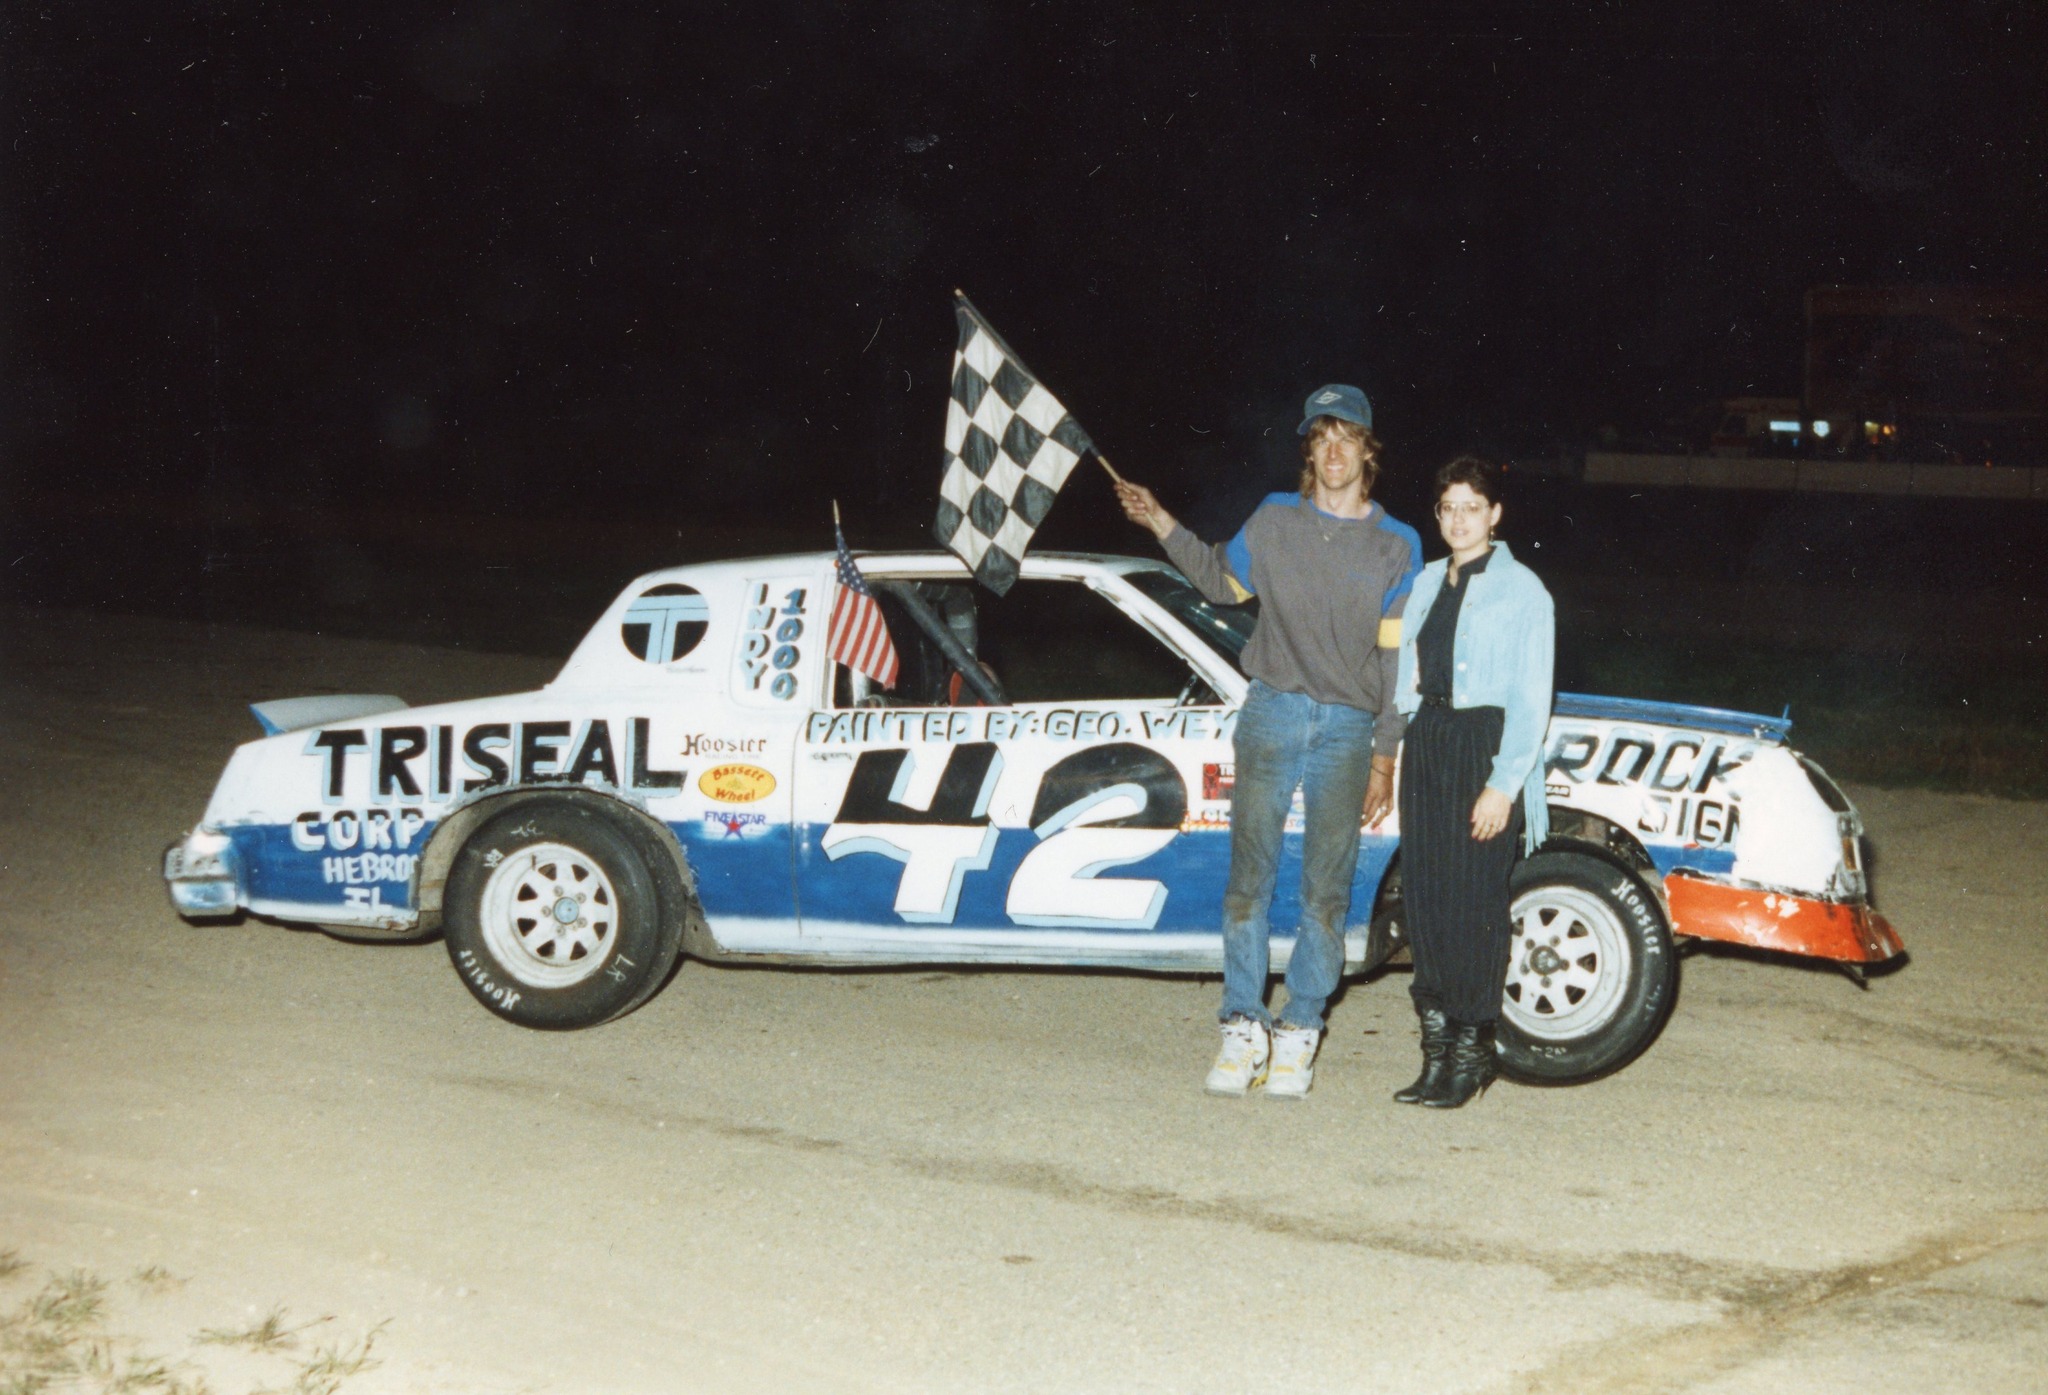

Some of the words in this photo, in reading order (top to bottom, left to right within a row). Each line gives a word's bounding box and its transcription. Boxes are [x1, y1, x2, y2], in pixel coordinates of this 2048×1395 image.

[739, 583, 776, 690] INDY
[771, 588, 807, 700] 1000
[681, 734, 767, 756] Hoosier
[806, 710, 973, 743] PAINTED
[302, 717, 688, 806] TRISEAL
[1545, 724, 1760, 793] ROCK
[704, 811, 731, 823] FIVE
[738, 812, 767, 825] STAR
[716, 788, 755, 801] Wheel
[291, 807, 424, 852] CORP
[821, 741, 1188, 929] 42
[344, 886, 393, 912] IL
[1610, 878, 1661, 954] Hoosier
